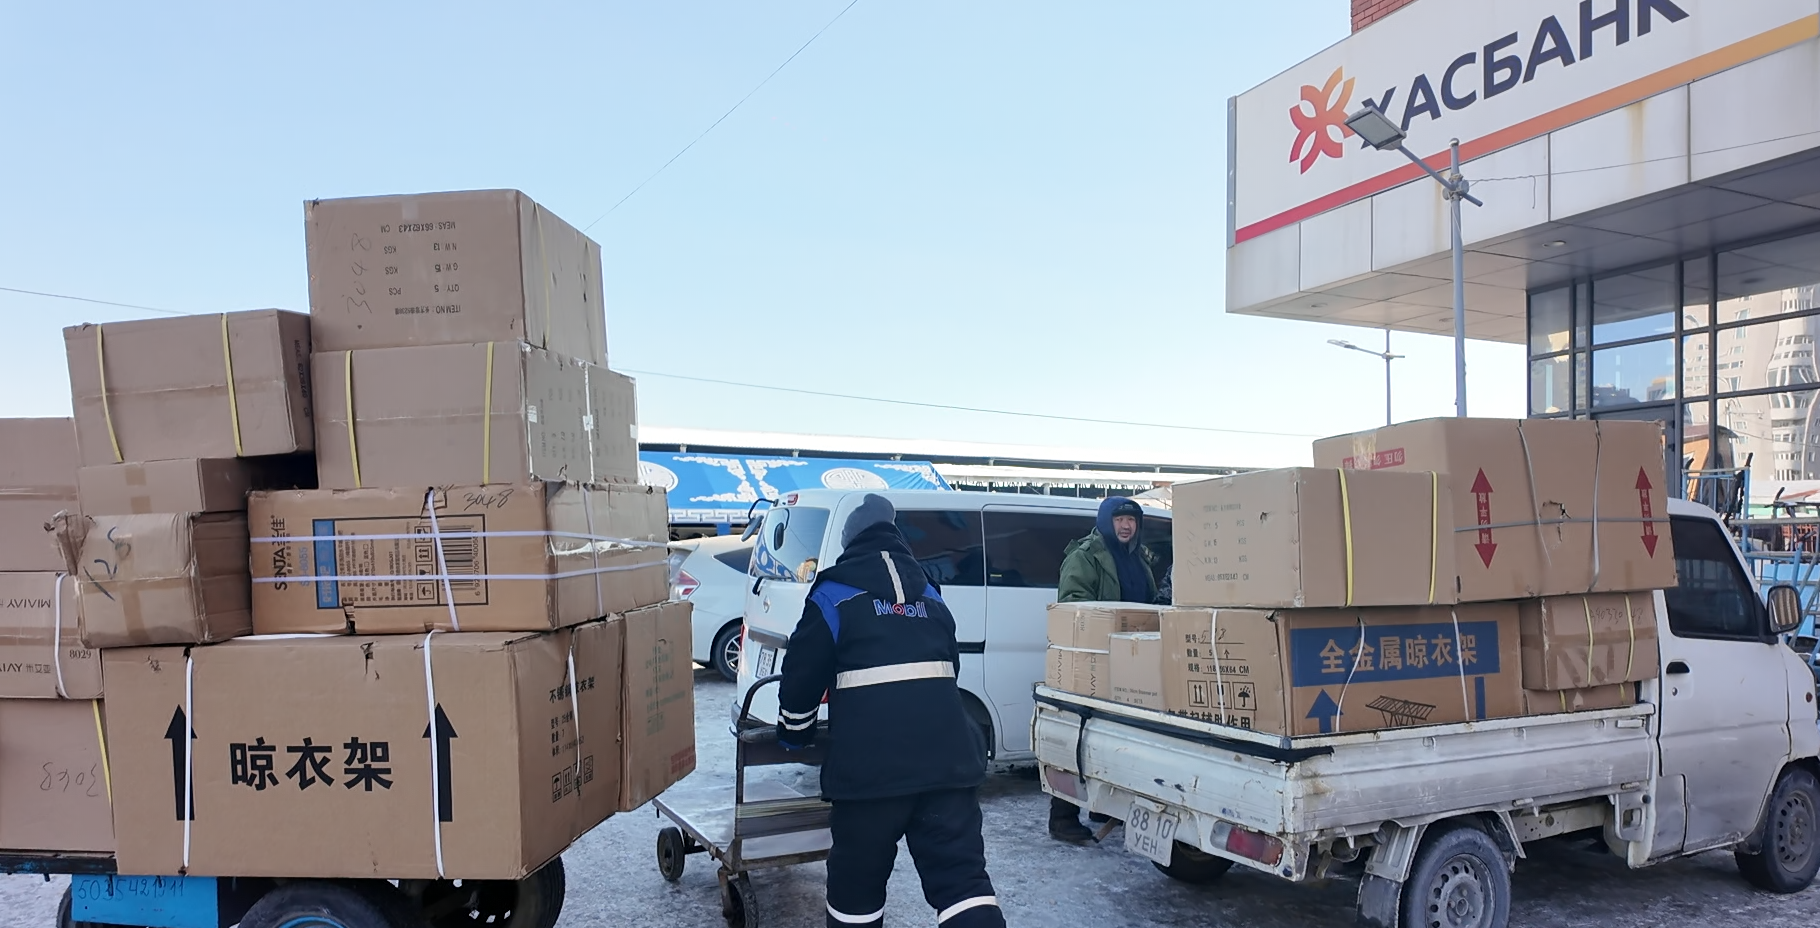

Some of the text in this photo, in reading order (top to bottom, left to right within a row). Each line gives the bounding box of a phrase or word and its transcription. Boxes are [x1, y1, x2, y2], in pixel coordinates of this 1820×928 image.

[464, 489, 514, 511] 3048
[873, 599, 928, 618] Mobil
[69, 650, 92, 659] 8029
[1319, 632, 1478, 674] 全金属晾衣架
[1239, 665, 1250, 674] CM
[229, 736, 394, 792] 晾衣架
